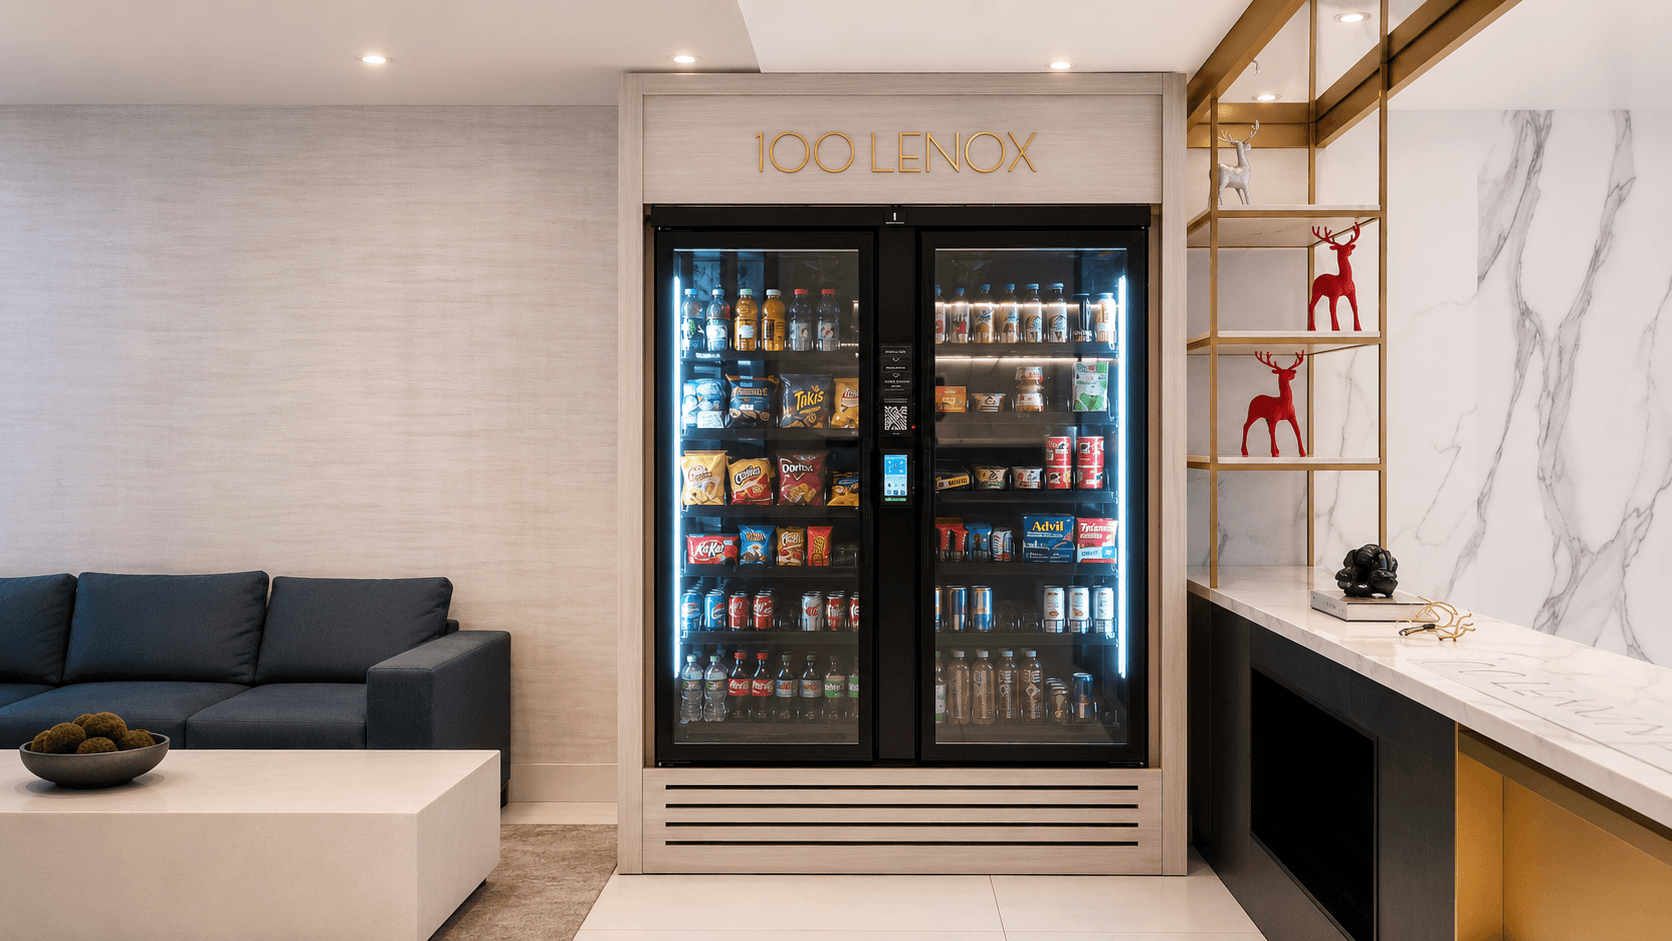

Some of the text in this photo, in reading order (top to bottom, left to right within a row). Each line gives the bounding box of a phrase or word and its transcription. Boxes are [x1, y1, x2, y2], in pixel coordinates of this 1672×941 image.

[754, 131, 1038, 173] 100 LENOX
[1032, 520, 1064, 531] Advil
